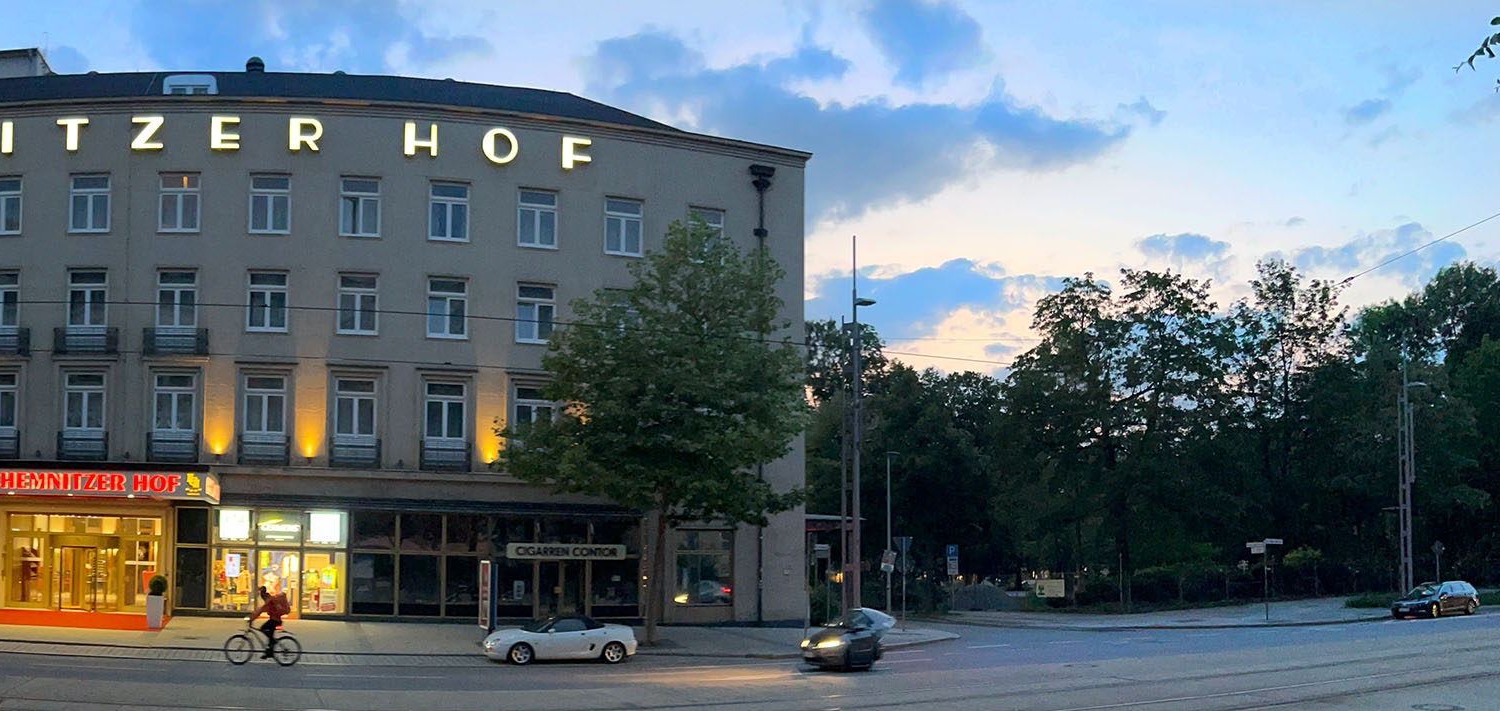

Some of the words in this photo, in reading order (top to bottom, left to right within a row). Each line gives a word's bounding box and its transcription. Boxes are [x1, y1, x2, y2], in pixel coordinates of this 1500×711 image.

[403, 122, 592, 170] HOF
[132, 474, 181, 493] HOF
[515, 546, 570, 556] CIGARREN
[573, 547, 618, 558] CONTOR
